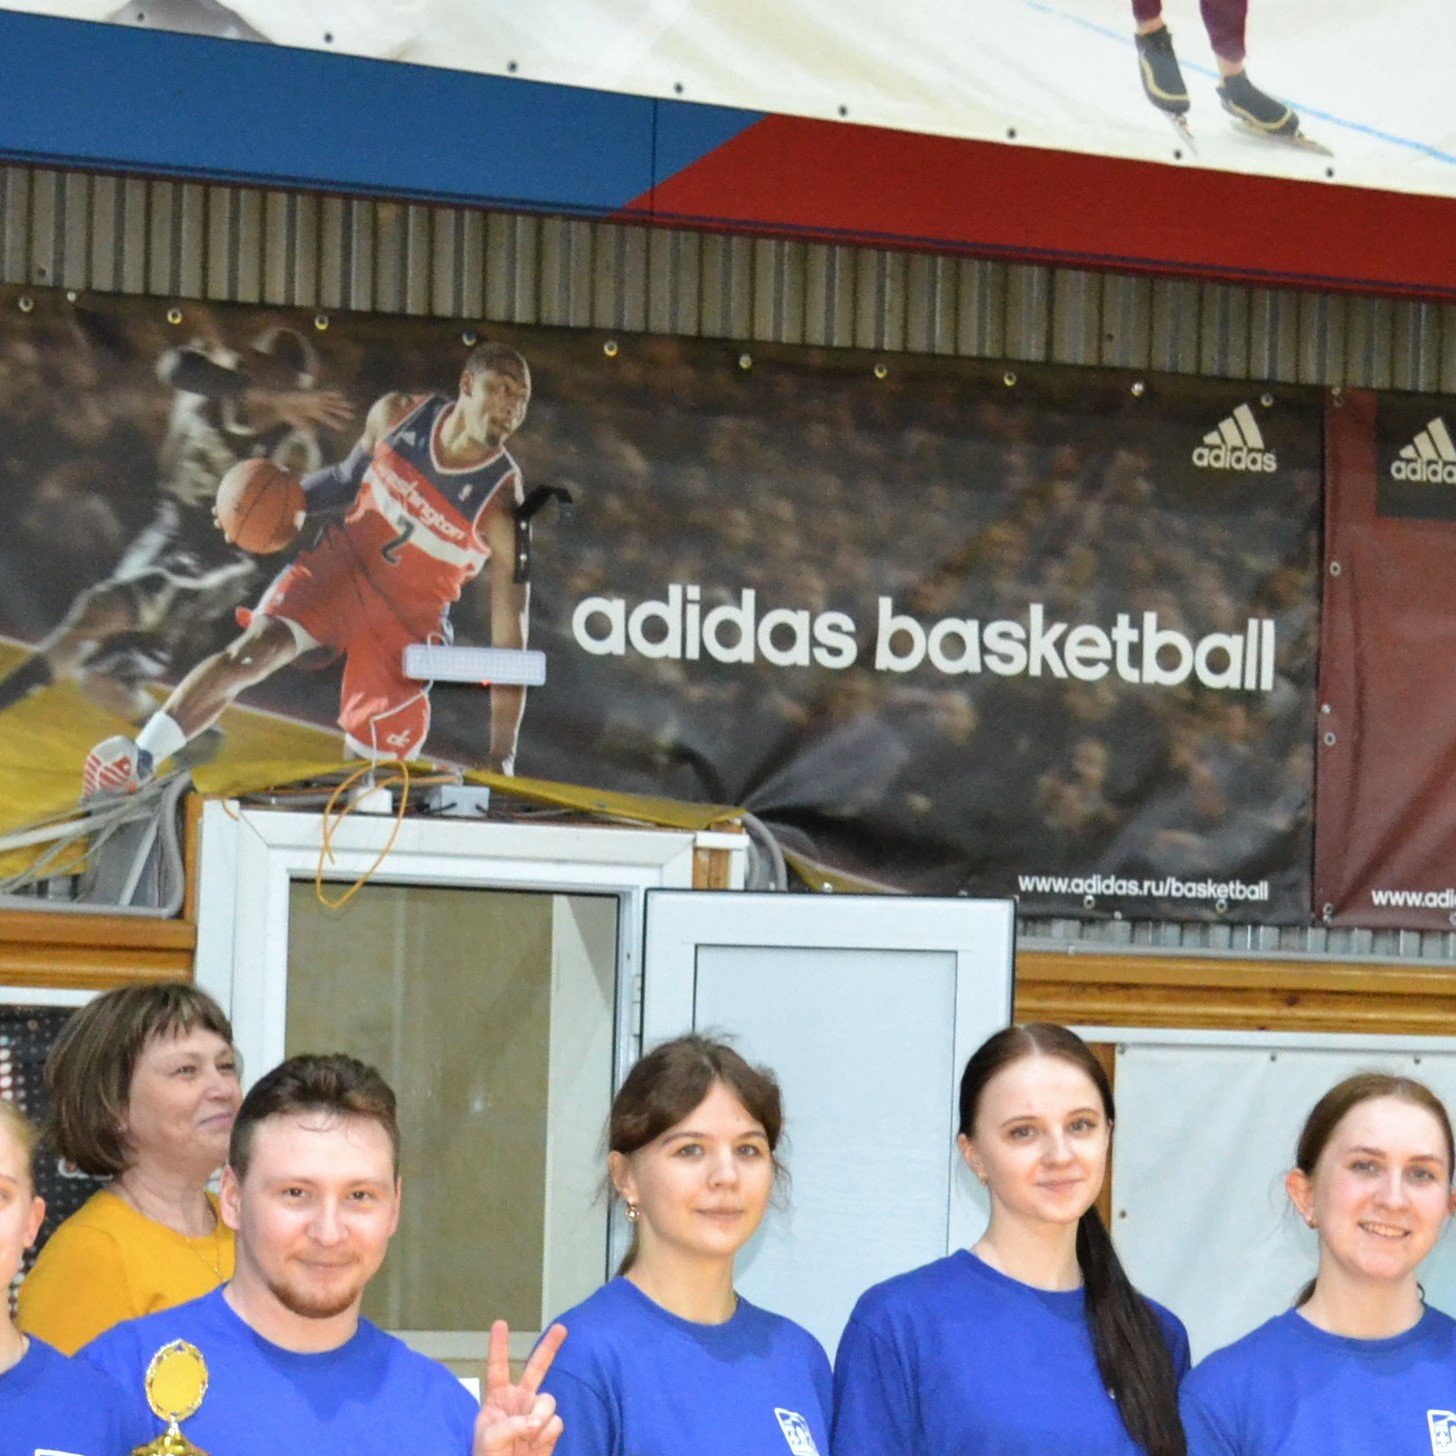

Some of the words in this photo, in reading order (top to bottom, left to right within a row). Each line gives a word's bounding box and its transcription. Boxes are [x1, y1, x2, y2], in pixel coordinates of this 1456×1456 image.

[1192, 443, 1277, 474] adidas
[571, 582, 858, 670] adidas
[875, 595, 1276, 692] basketball
[1016, 873, 1269, 902] www.adidas.ru/basketball
